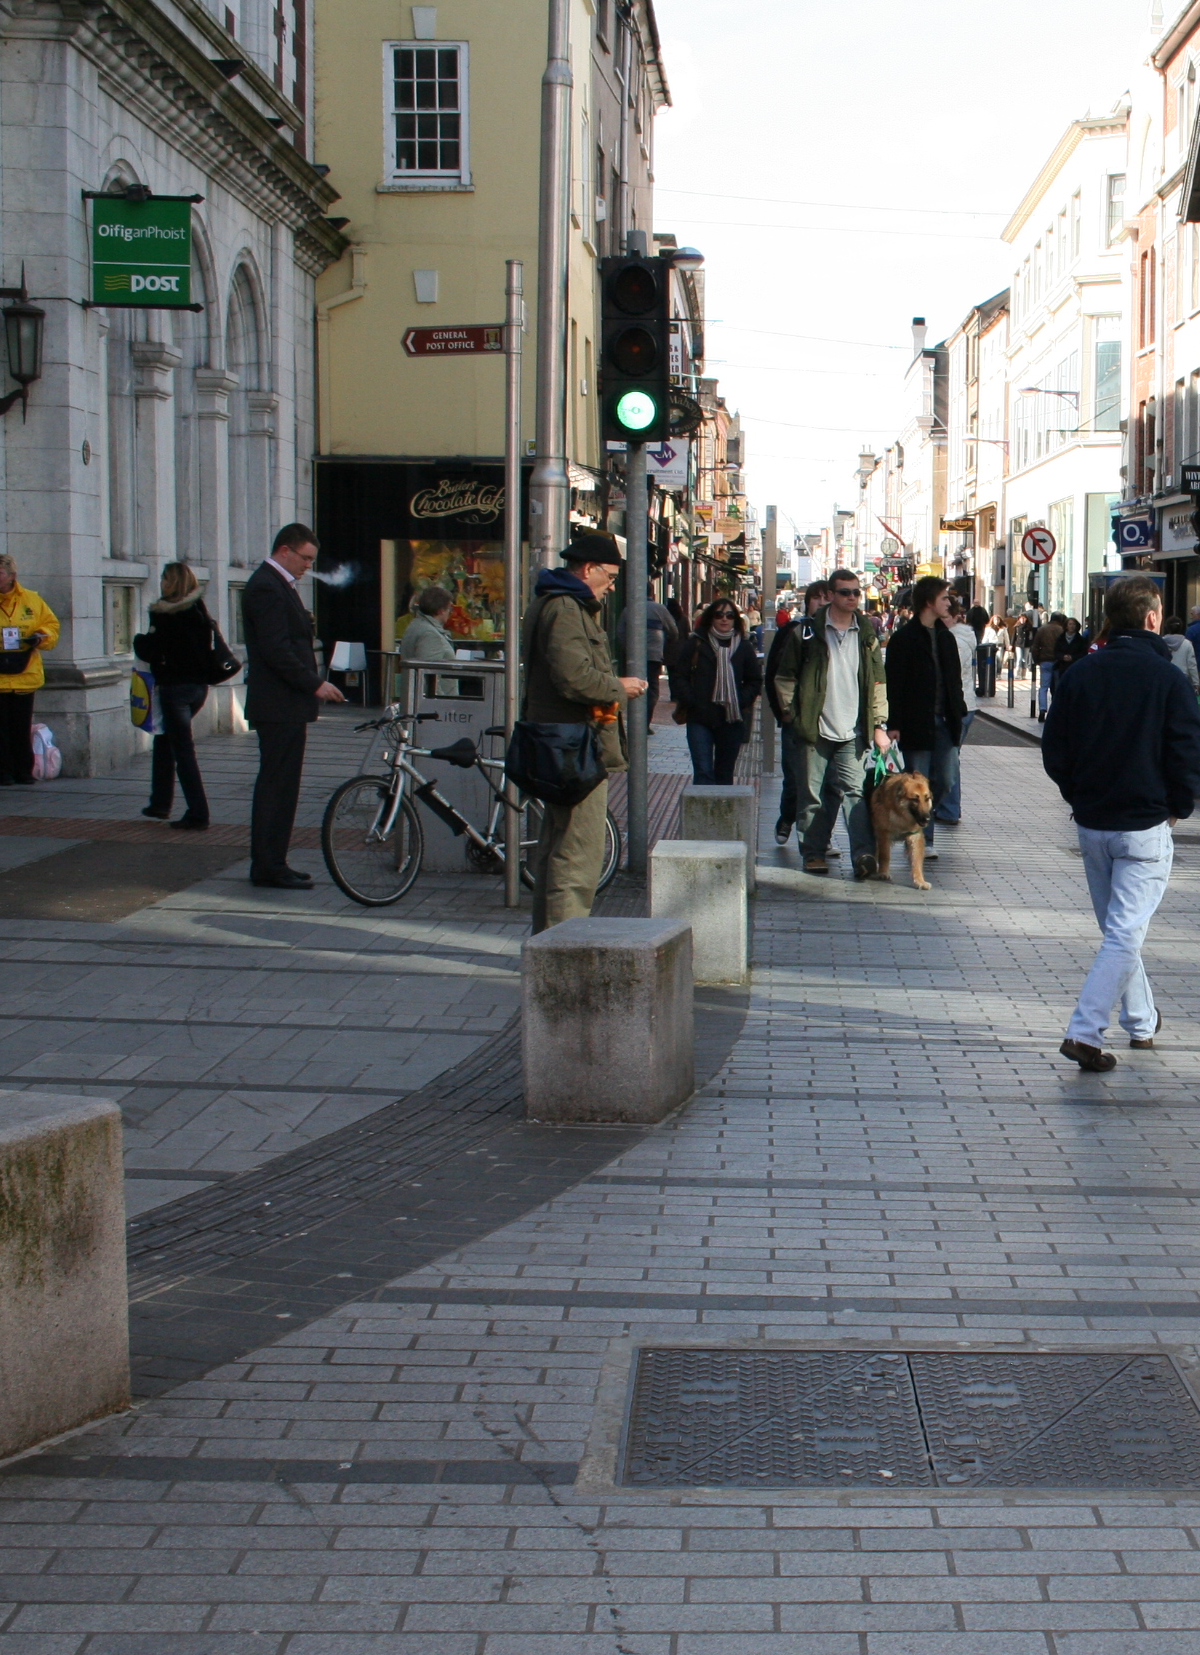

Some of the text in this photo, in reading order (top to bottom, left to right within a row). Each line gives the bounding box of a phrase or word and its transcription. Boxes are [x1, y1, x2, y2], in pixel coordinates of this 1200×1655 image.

[98, 224, 186, 241] OifiganPhoist
[130, 275, 180, 293] post
[432, 331, 468, 340] GENERAL
[426, 341, 475, 350] POST OFFICE
[410, 489, 476, 518] Chocolate
[1123, 523, 1145, 544] O2
[435, 711, 473, 723] Litter
